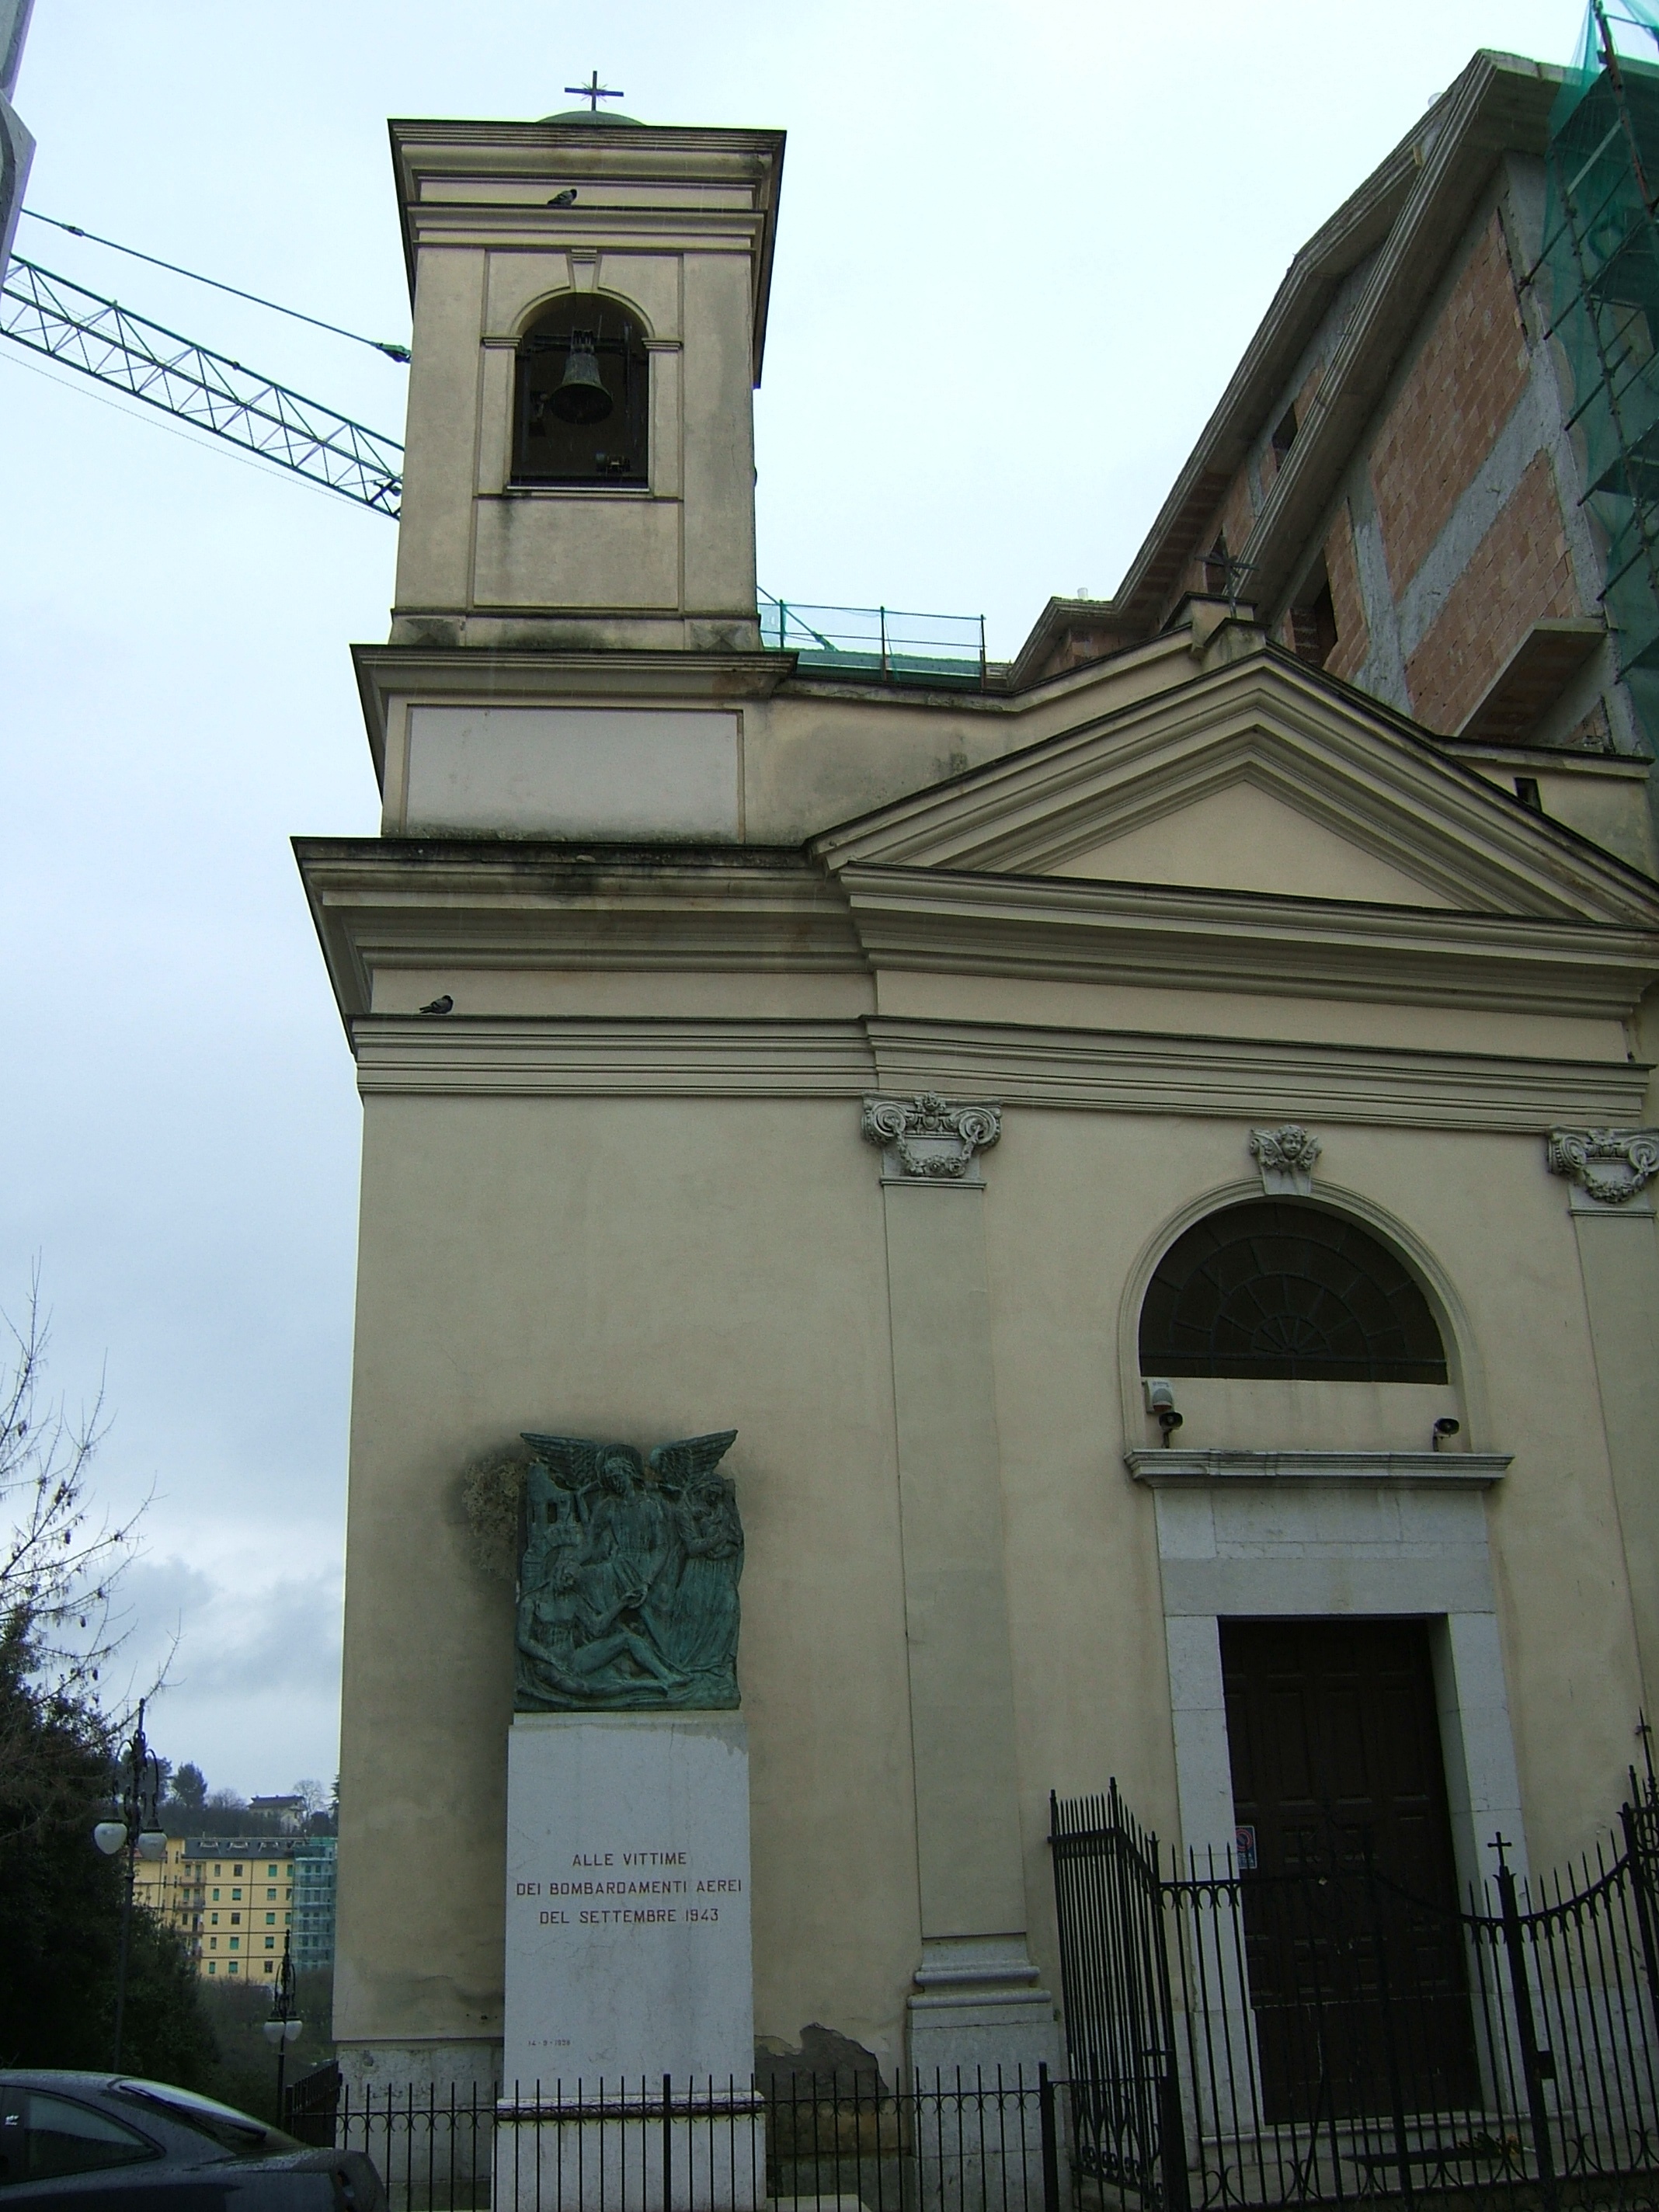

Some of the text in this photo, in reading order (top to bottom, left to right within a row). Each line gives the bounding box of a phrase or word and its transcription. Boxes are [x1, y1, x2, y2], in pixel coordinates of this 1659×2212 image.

[572, 1852, 687, 1866] ALLE VITTIME
[516, 1880, 742, 1895] DEI BOMBARDAMENTI AEREI
[540, 1908, 718, 1924] DEL SETTEMBRE 1943
